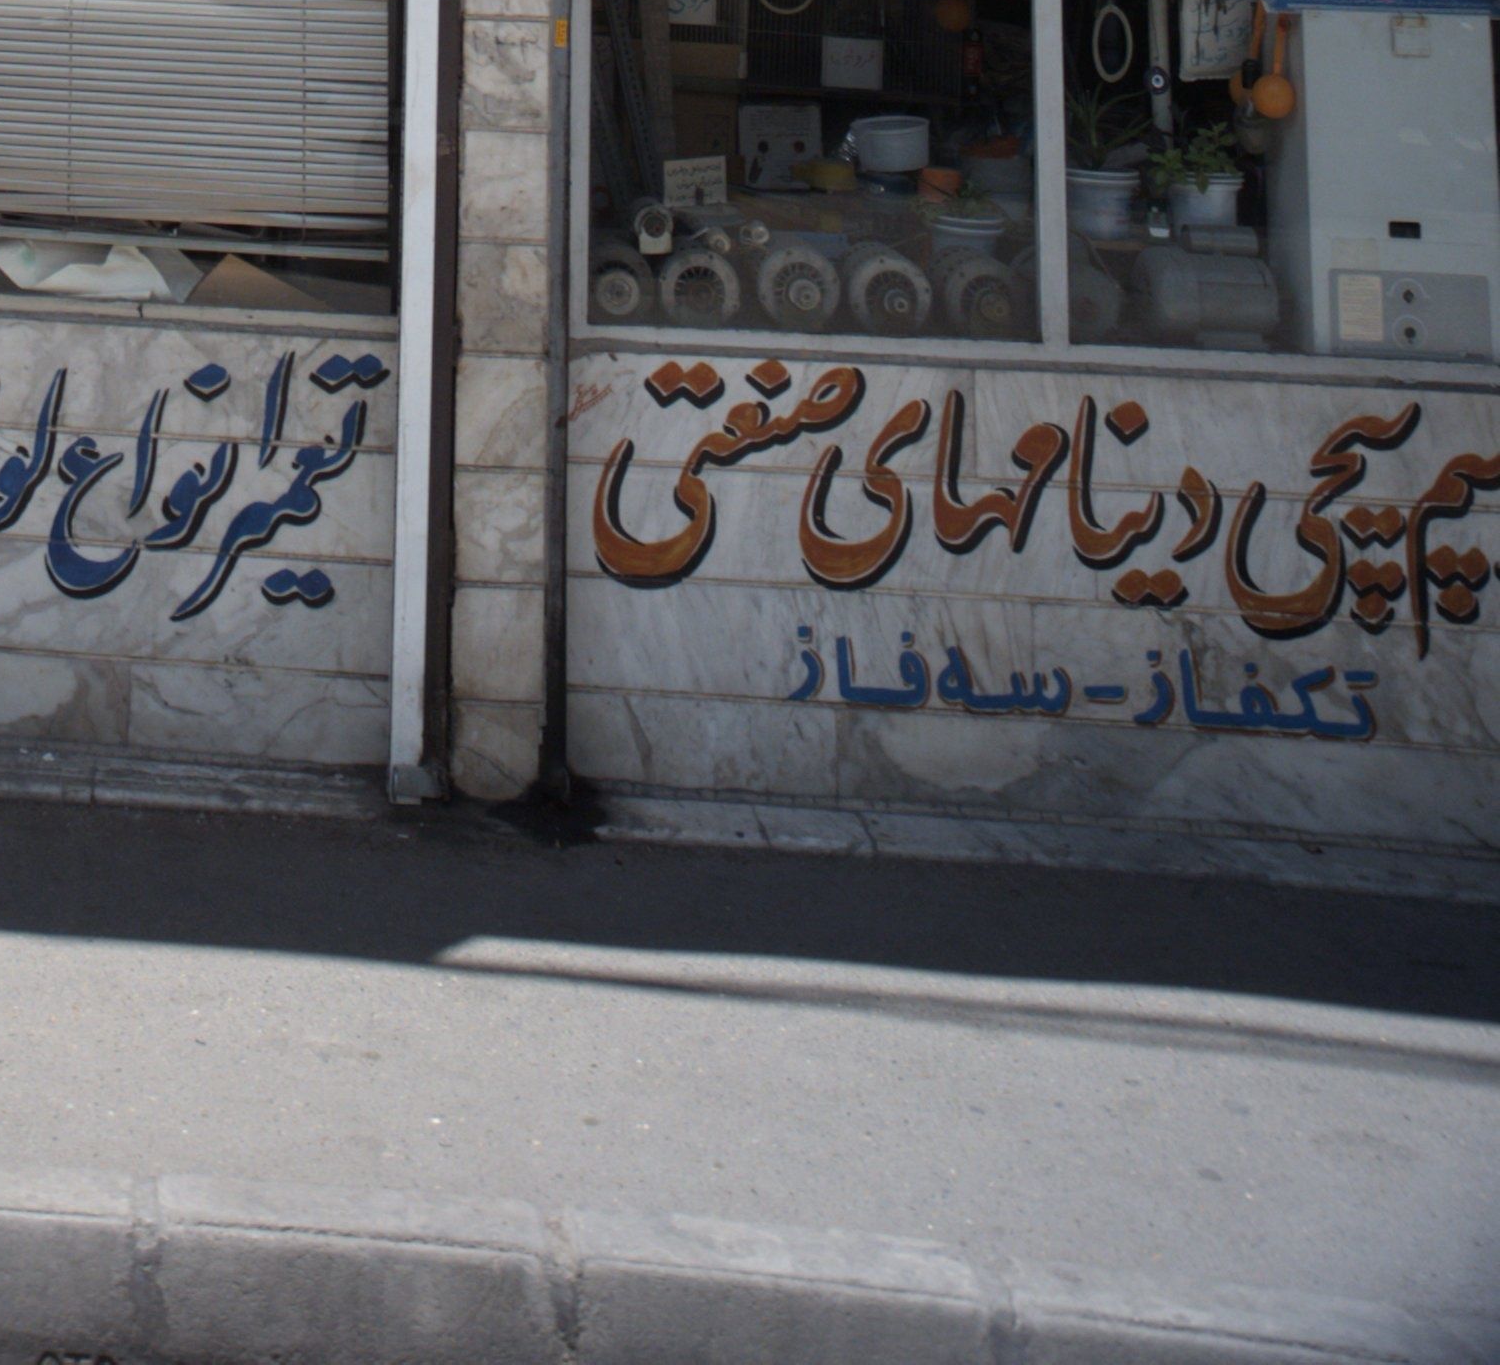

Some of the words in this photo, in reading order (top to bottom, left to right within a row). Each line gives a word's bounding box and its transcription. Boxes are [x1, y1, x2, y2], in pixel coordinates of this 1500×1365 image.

[46, 350, 297, 599] انواع
[171, 350, 391, 621] تعمیر
[591, 358, 867, 590] صنعتی
[797, 387, 1224, 607] دینامهای
[1224, 400, 1422, 640] پیچی
[786, 623, 934, 709] فاز
[936, 645, 1072, 718] سه
[1132, 649, 1380, 743] تکفاز
